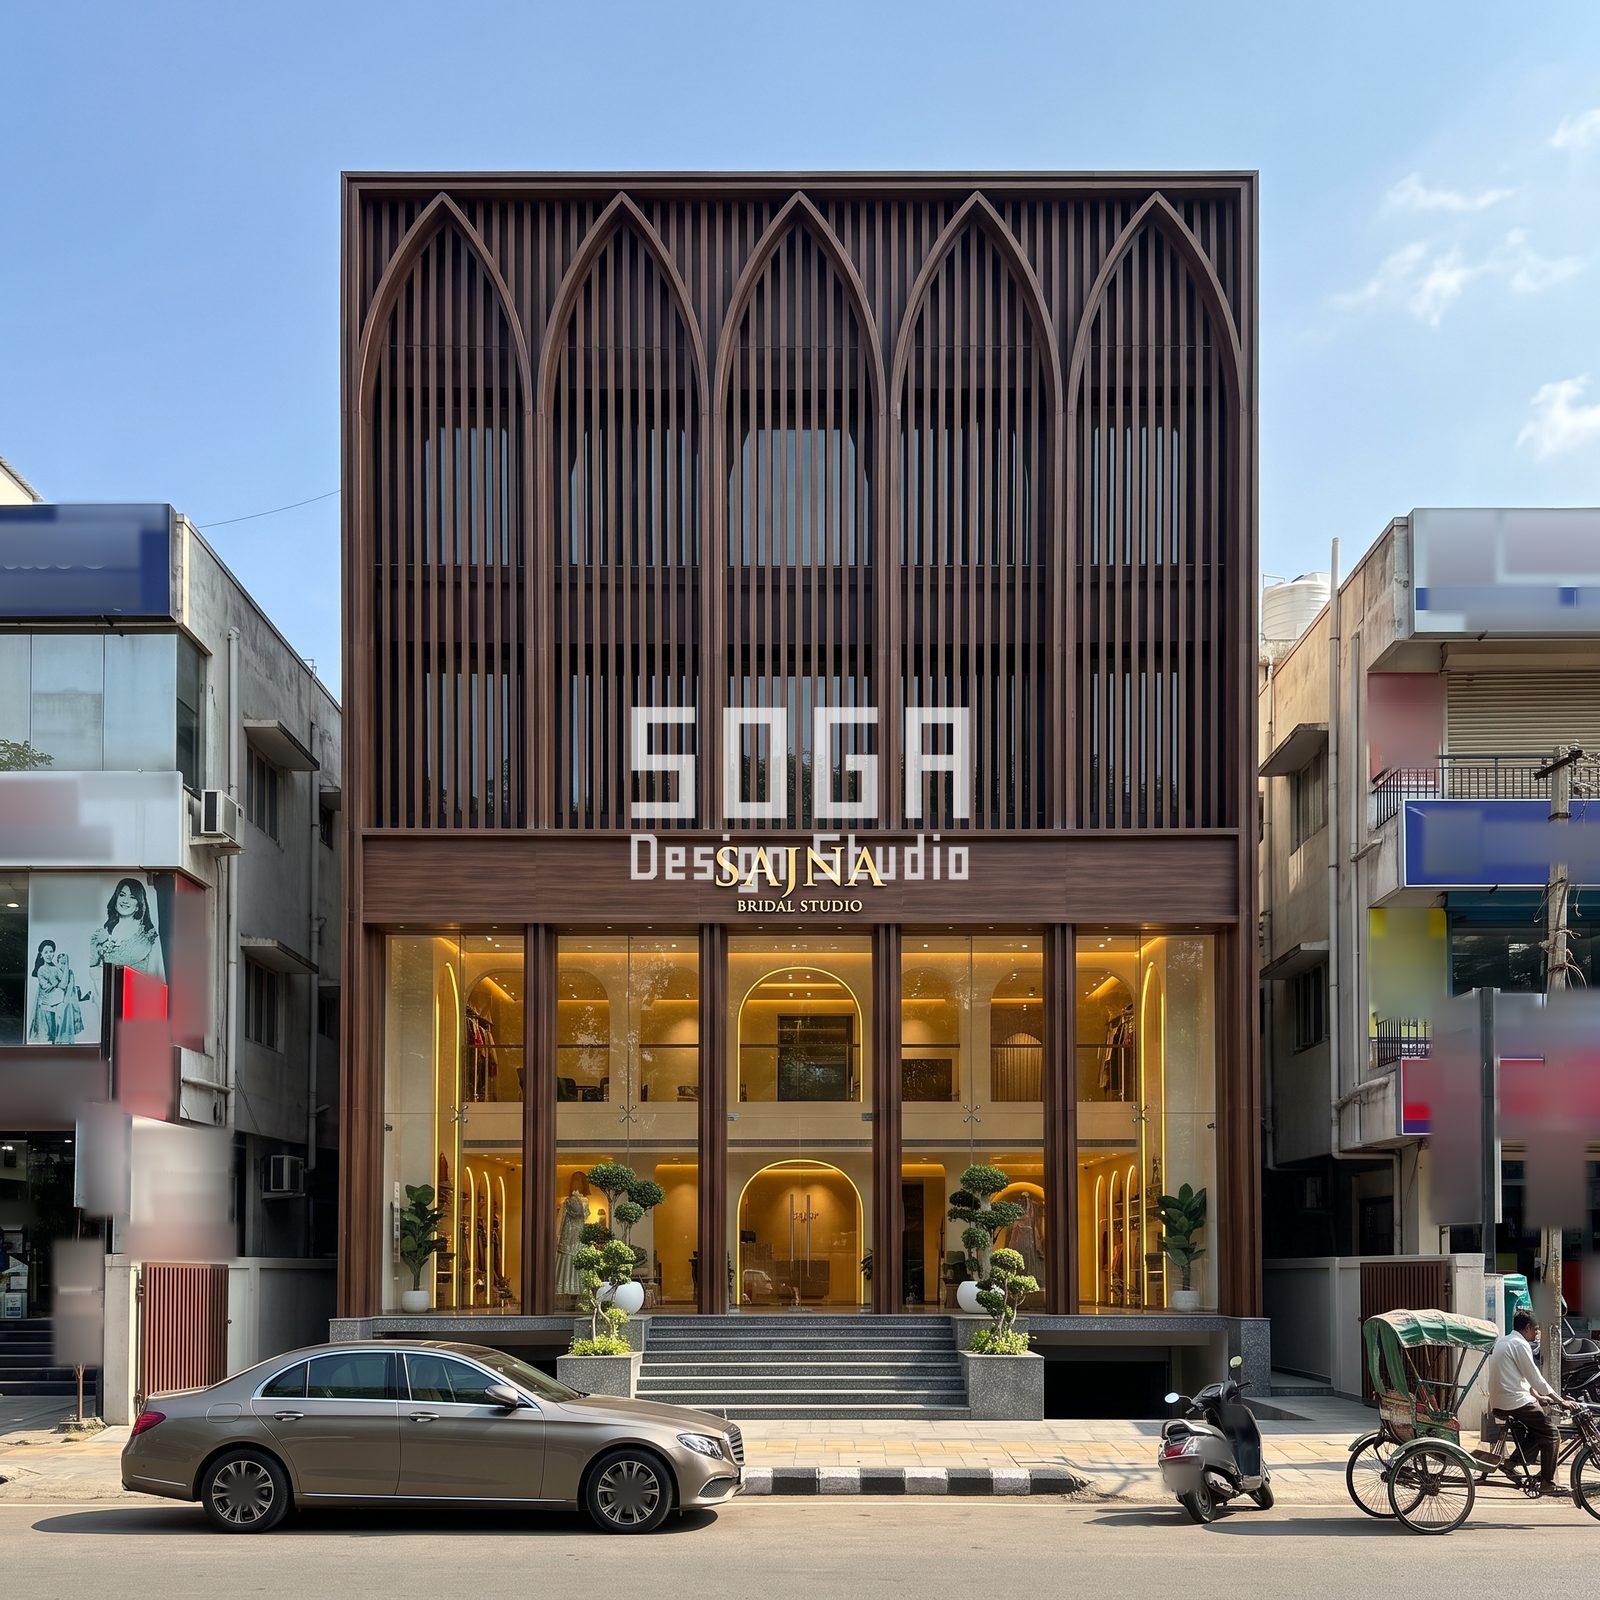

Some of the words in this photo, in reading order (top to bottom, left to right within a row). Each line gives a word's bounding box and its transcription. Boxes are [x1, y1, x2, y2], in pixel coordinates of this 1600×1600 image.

[715, 846, 888, 898] SAJNA
[737, 900, 796, 912] BRIDAL
[800, 900, 863, 912] STUDIO
